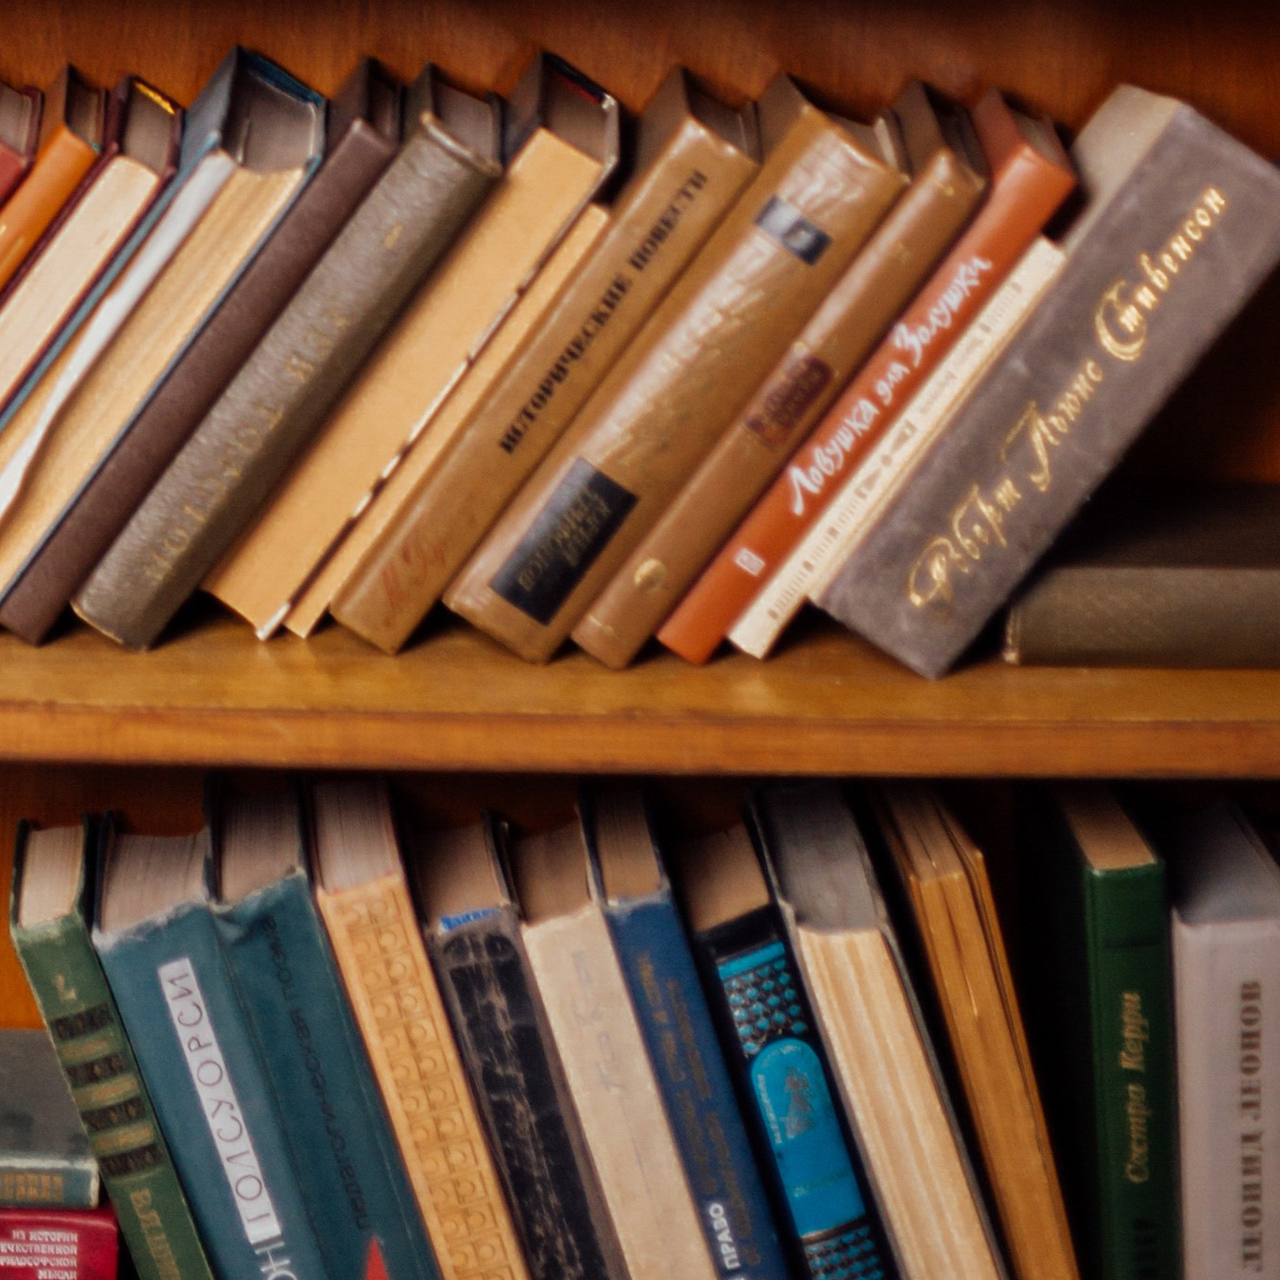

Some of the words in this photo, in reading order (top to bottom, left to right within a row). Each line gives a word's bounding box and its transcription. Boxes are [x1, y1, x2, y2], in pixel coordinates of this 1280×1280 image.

[497, 271, 633, 455] ИСТОРИЧЕСКИЕ
[626, 169, 708, 272] ПОВЕСТИ
[885, 248, 994, 367] Золушки
[1094, 187, 1227, 362] Стивенсон
[869, 358, 912, 406] для
[773, 390, 881, 517] Ловушка
[171, 971, 271, 1225] ГОЛСУОРСИ
[1238, 982, 1263, 1120] ЛЕОНОВ
[29, 1230, 78, 1243] ИСТОРИИ
[707, 1201, 740, 1269] ПРАВО
[1240, 1129, 1265, 1272] ЛЕОНИД
